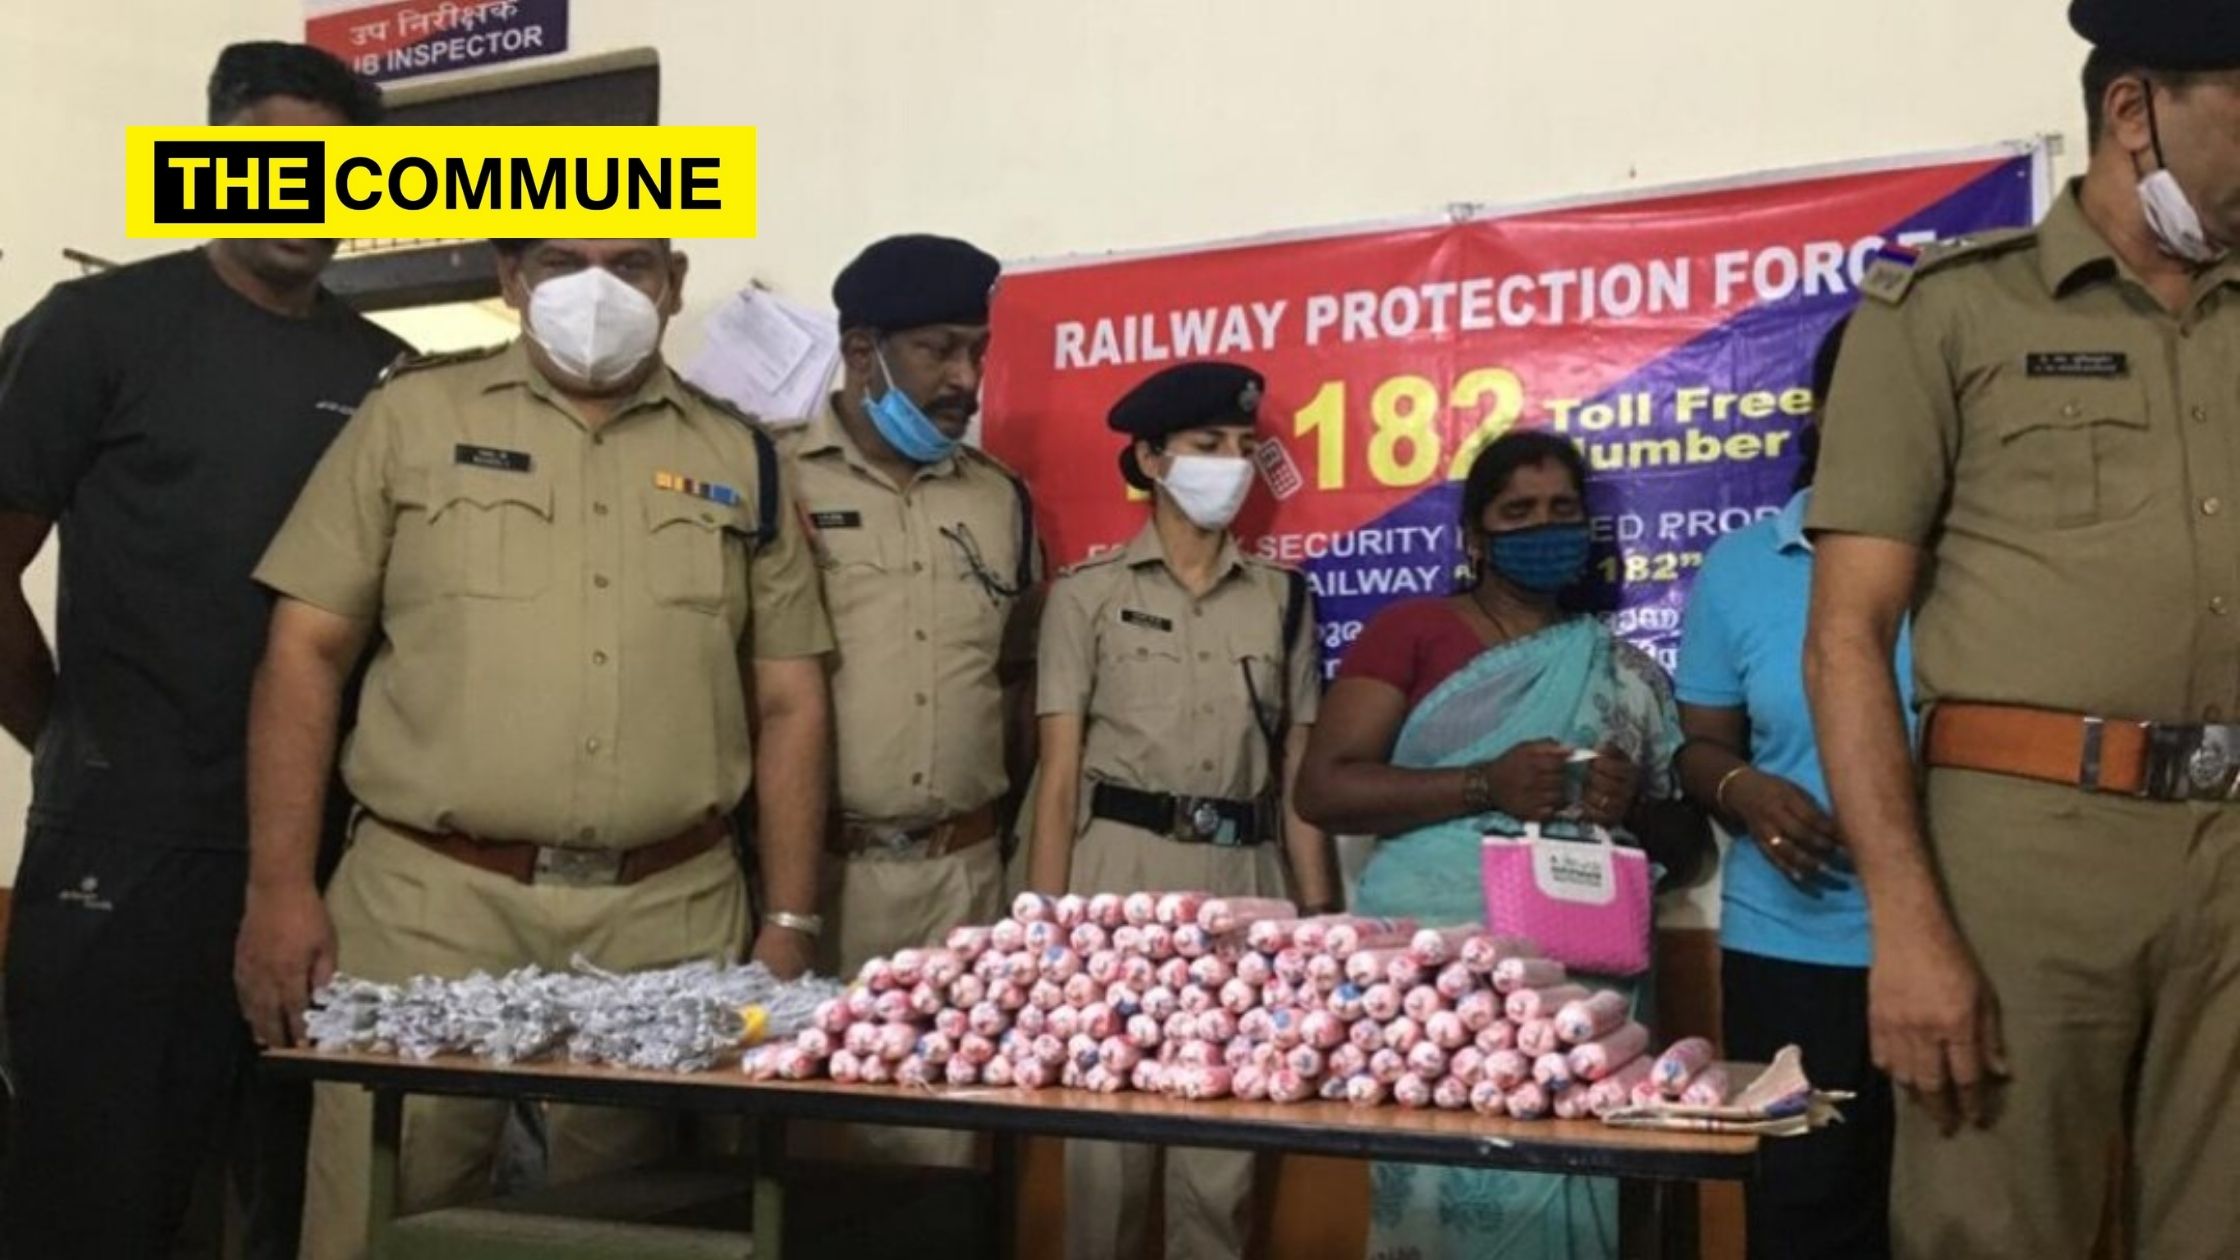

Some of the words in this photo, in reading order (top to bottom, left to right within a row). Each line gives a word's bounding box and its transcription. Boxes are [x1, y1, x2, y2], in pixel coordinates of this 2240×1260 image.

[349, 19, 390, 46] उप
[387, 24, 544, 72] INSPECTOR
[1053, 300, 1289, 369] RAILWAY
[1304, 257, 1690, 346] PROTECTION
[1714, 230, 1937, 306] FORC
[1544, 387, 1653, 432] Toll
[1675, 384, 1814, 424] Free
[1574, 427, 1791, 470] umber
[1257, 525, 1444, 561] SECURITY
[1303, 565, 1442, 597] AILWAY
